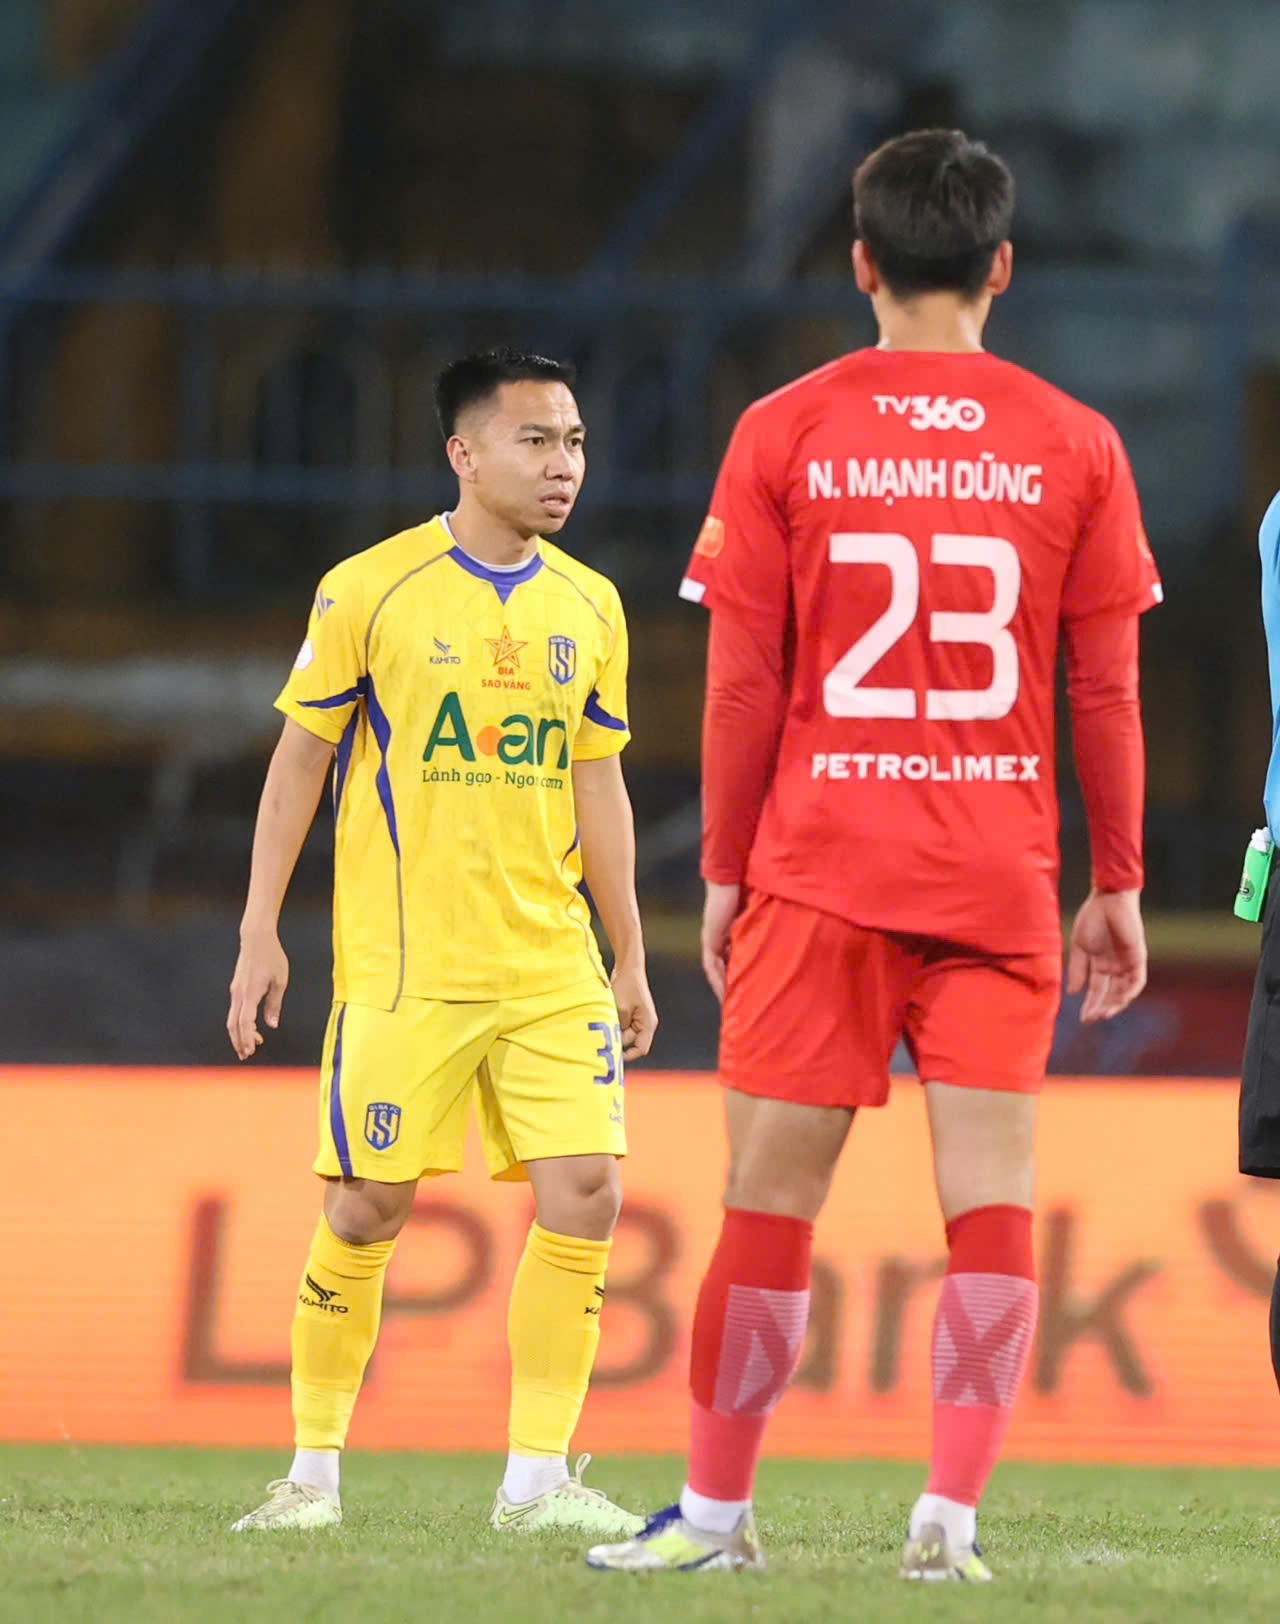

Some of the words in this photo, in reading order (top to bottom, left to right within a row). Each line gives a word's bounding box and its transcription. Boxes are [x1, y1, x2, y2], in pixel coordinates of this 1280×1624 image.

[872, 395, 987, 432] TV360
[807, 460, 841, 500] N.
[847, 457, 947, 506] MẠNH
[953, 451, 1043, 505] DŨNG
[823, 533, 1021, 721] 23
[422, 767, 461, 783] Lành
[504, 771, 540, 789] Ngo
[811, 752, 1040, 782] PETROLIMEX
[587, 1022, 624, 1087] 3
